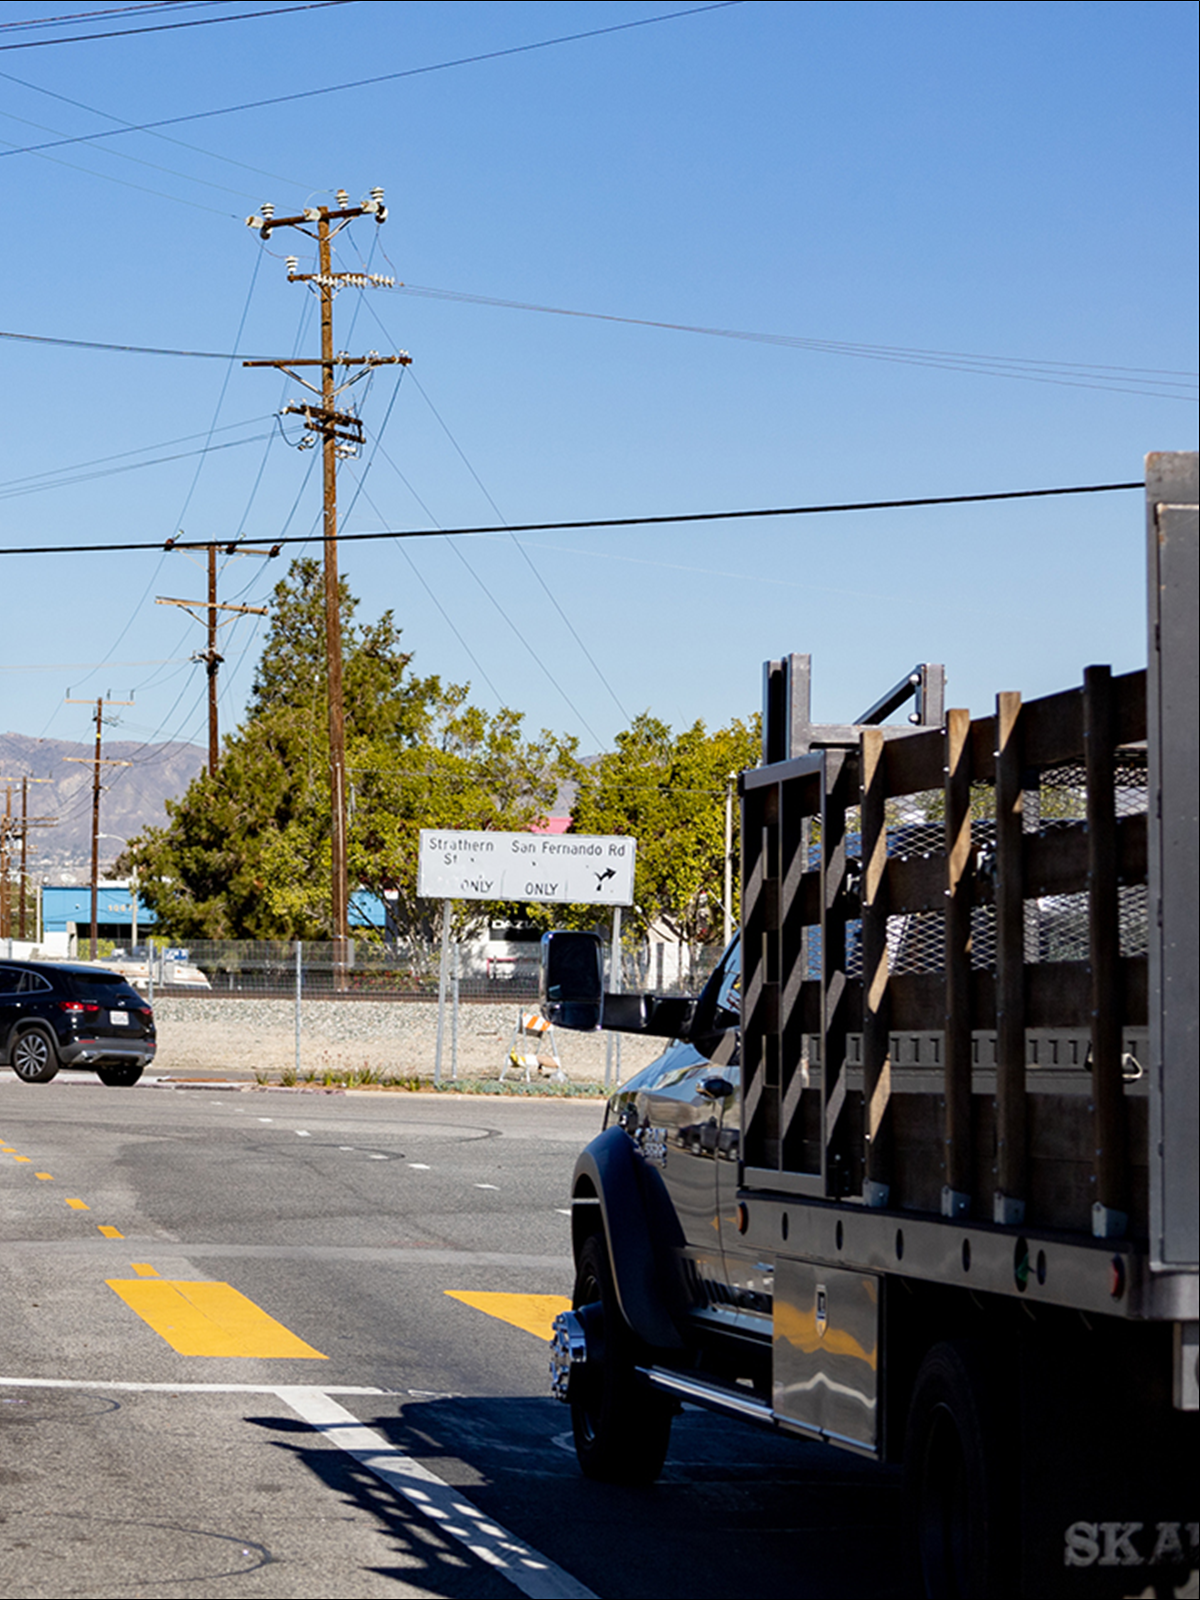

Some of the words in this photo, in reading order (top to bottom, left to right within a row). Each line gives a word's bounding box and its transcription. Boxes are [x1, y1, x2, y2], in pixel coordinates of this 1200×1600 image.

[429, 837, 495, 852] Strathern
[511, 840, 536, 854] San
[542, 841, 603, 856] Fernando
[608, 843, 626, 857] Rd
[443, 852, 457, 865] St
[460, 879, 494, 893] ONLY
[525, 882, 559, 896] ONLY
